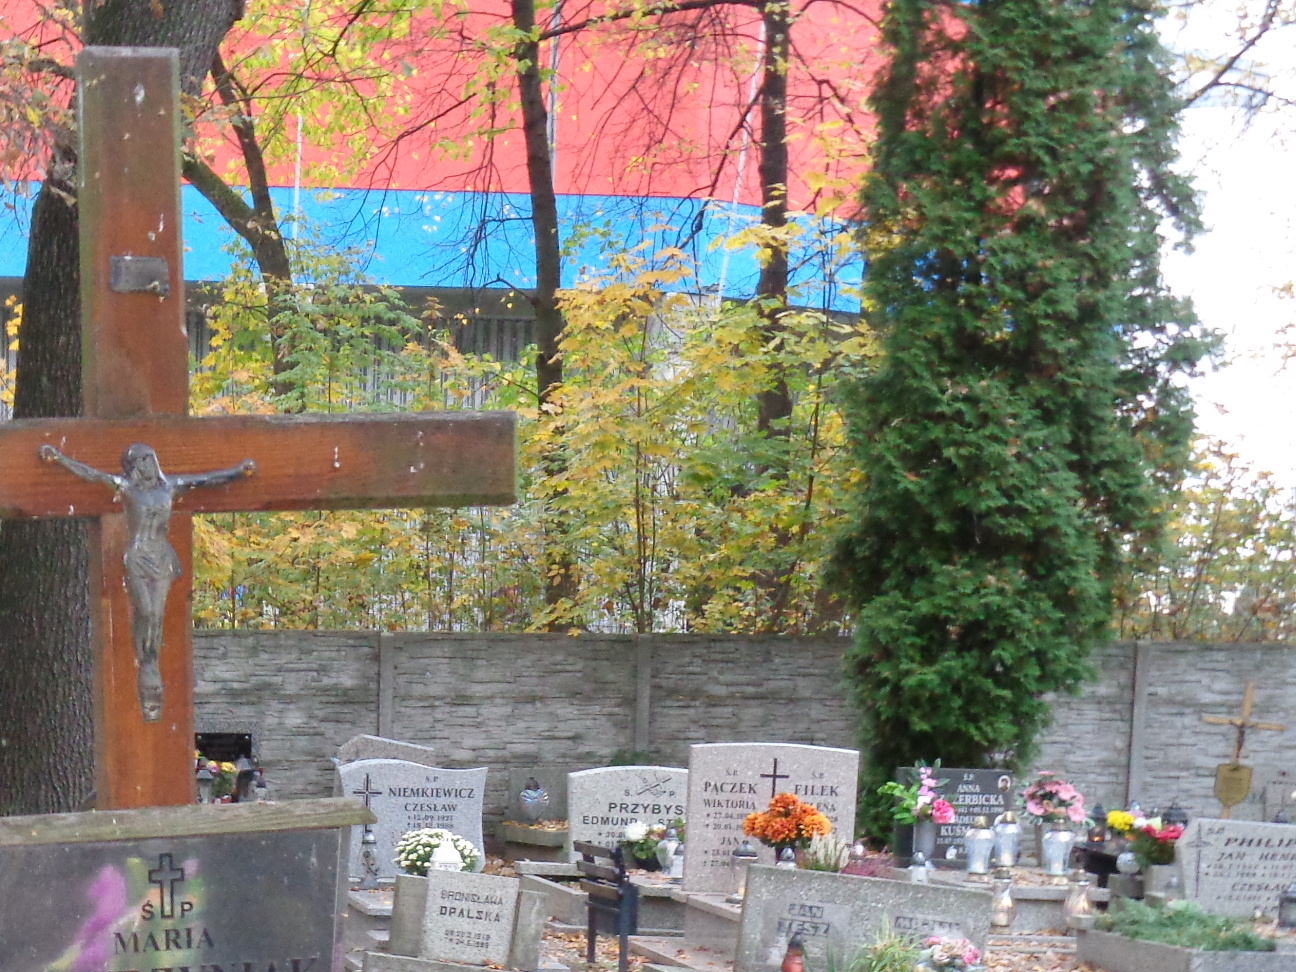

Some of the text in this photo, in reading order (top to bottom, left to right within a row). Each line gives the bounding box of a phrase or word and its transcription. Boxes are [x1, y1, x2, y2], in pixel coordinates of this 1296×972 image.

[388, 787, 475, 799] NIEMKIEWICZ
[704, 781, 757, 796] PĄCZEK
[795, 784, 840, 797] FILEK
[956, 784, 981, 793] ANNA
[404, 802, 458, 812] CZESŁAW
[704, 798, 756, 809] WIKTORIA
[440, 905, 501, 922] OPALSKA
[114, 927, 215, 955] MARIA
